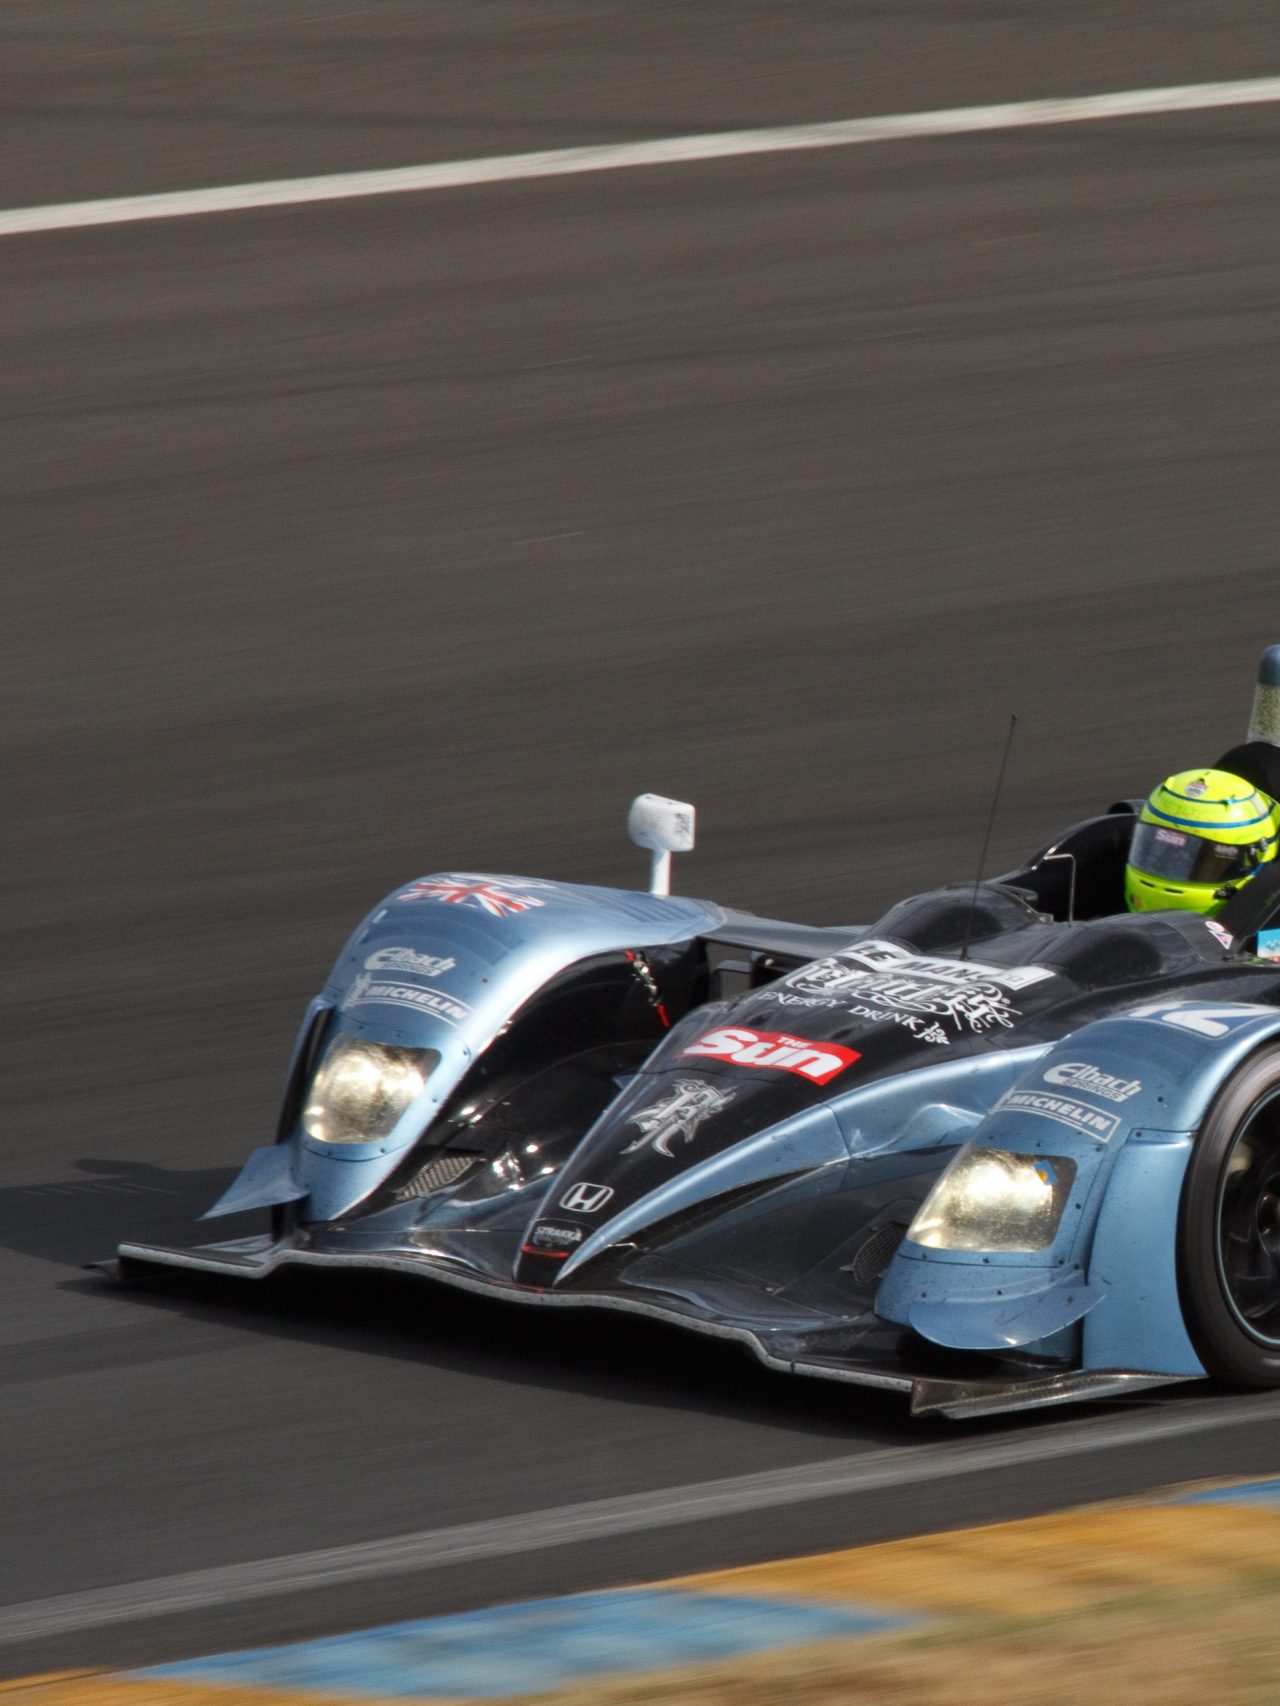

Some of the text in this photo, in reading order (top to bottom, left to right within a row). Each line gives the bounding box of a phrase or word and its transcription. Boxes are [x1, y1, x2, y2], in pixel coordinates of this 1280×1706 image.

[364, 985, 469, 1019] MICHELIN
[757, 990, 926, 1032] ENERGY DRINK
[684, 1029, 843, 1077] Sun
[777, 1036, 814, 1048] THE
[1007, 1094, 1111, 1131] MICHELIN
